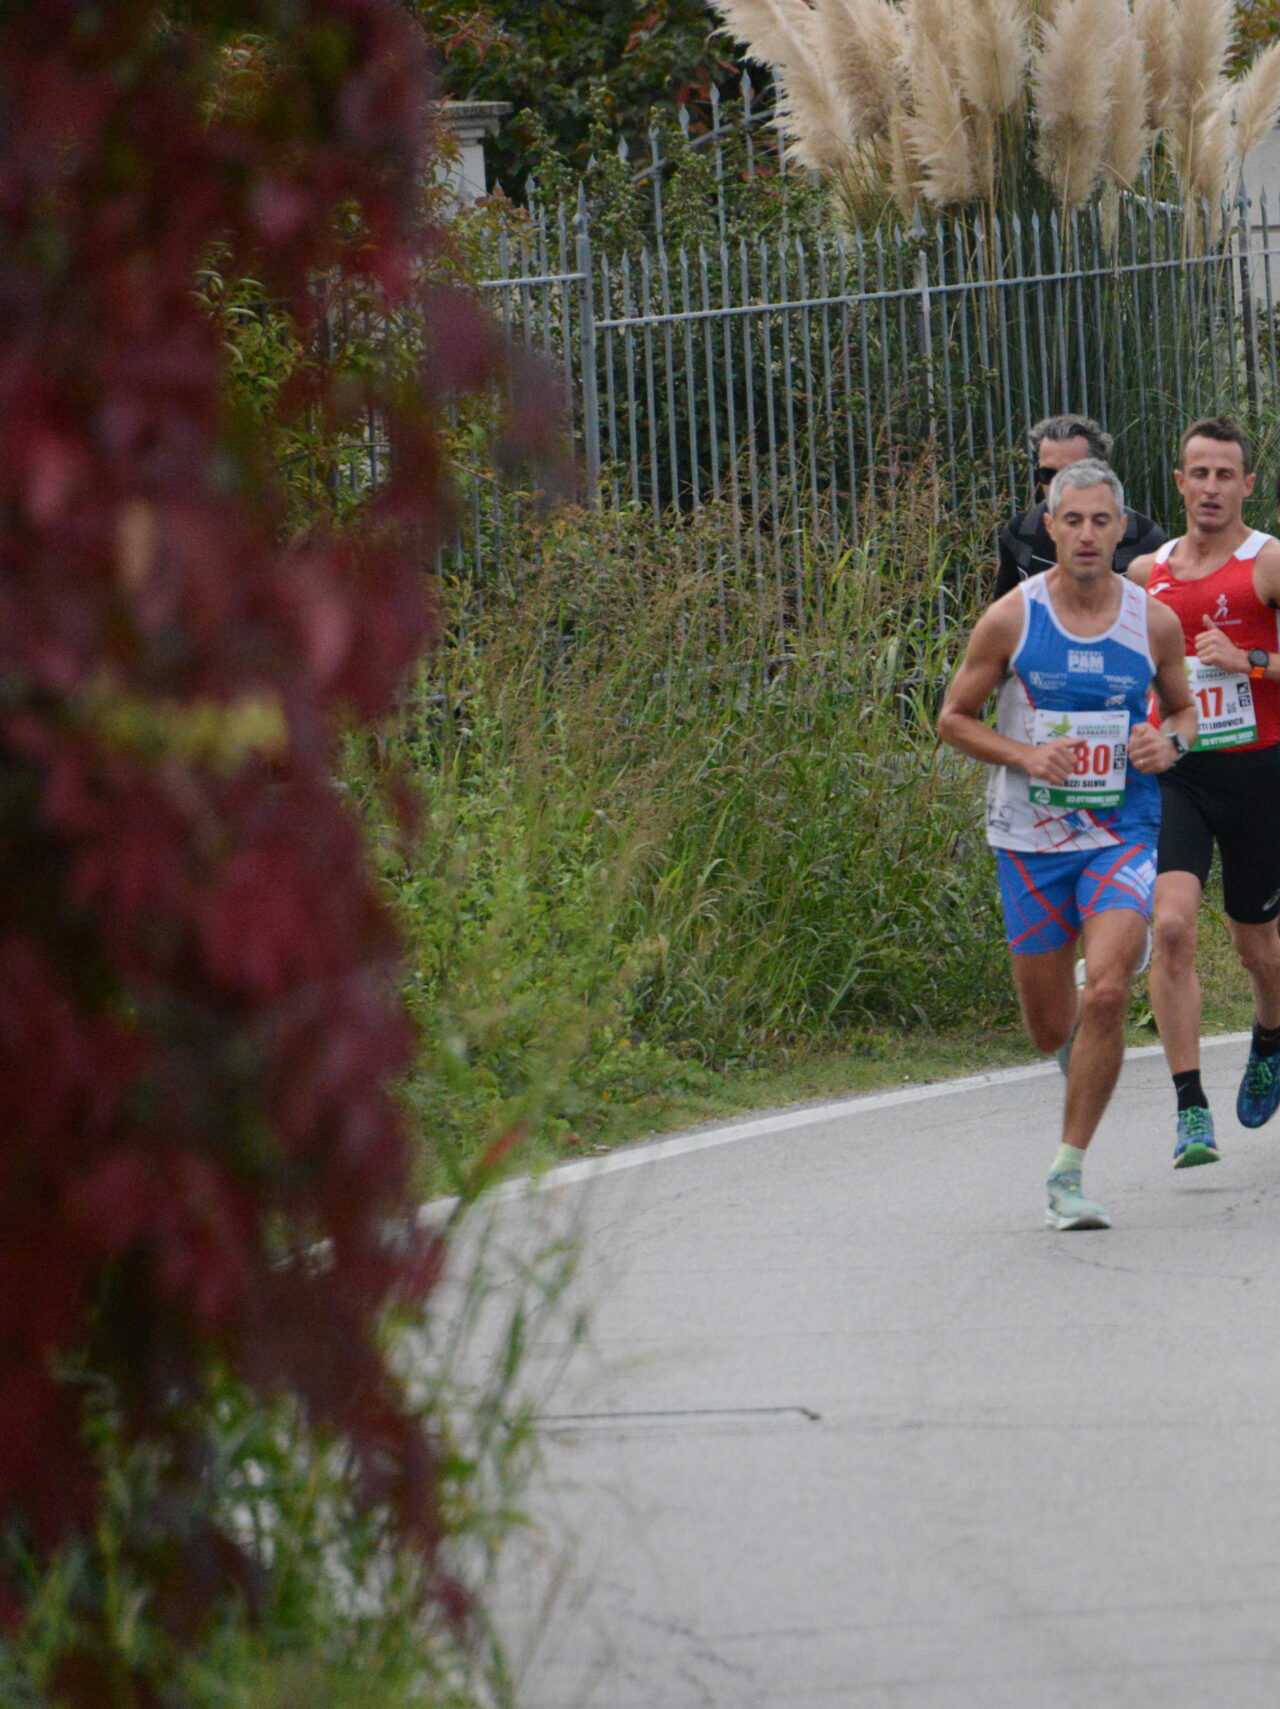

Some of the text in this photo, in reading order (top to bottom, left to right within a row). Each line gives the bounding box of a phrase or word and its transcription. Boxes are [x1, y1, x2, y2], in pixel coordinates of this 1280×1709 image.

[1068, 656, 1104, 668] PAM
[1190, 687, 1223, 718] 17
[1210, 717, 1244, 730] LUDOVICO
[1072, 744, 1111, 776] 80
[1082, 779, 1107, 787] SILVIO
